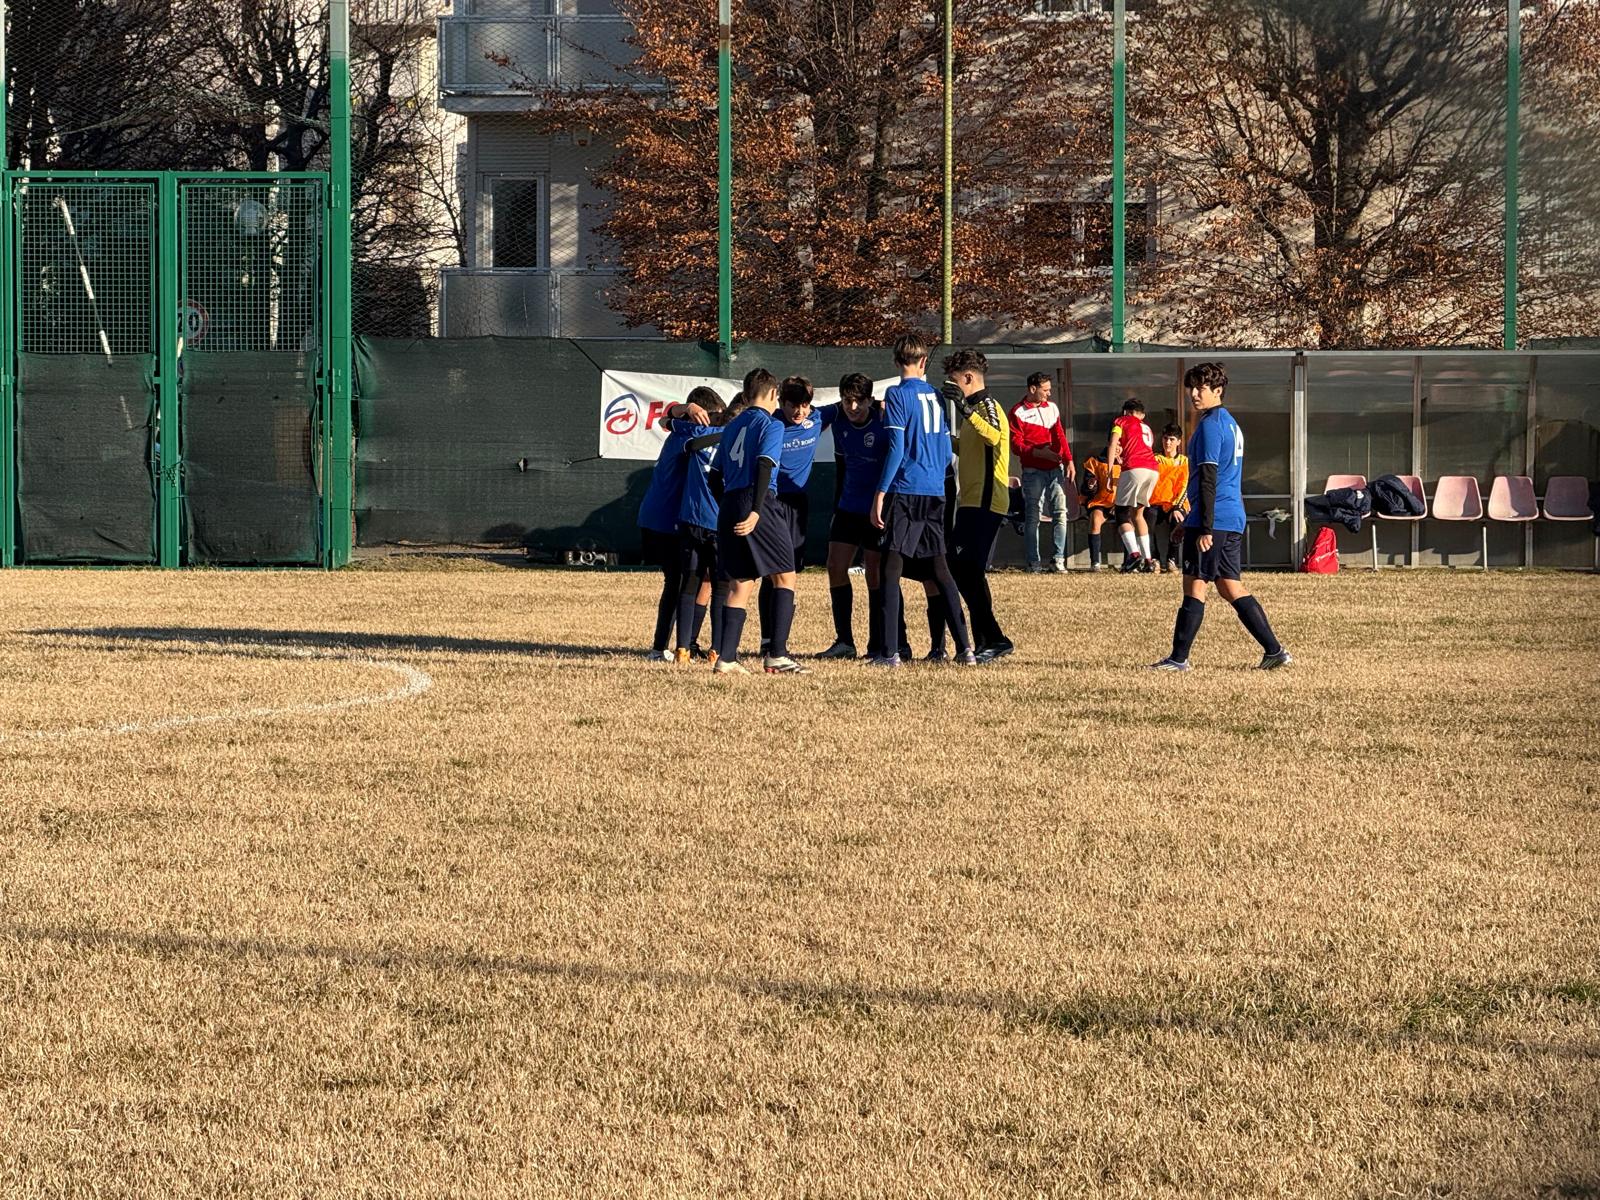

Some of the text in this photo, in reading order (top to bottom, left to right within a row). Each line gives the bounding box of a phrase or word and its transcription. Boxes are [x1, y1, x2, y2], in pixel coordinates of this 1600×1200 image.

[917, 392, 941, 434] 11
[729, 426, 747, 468] 4
[1139, 422, 1155, 448] 5
